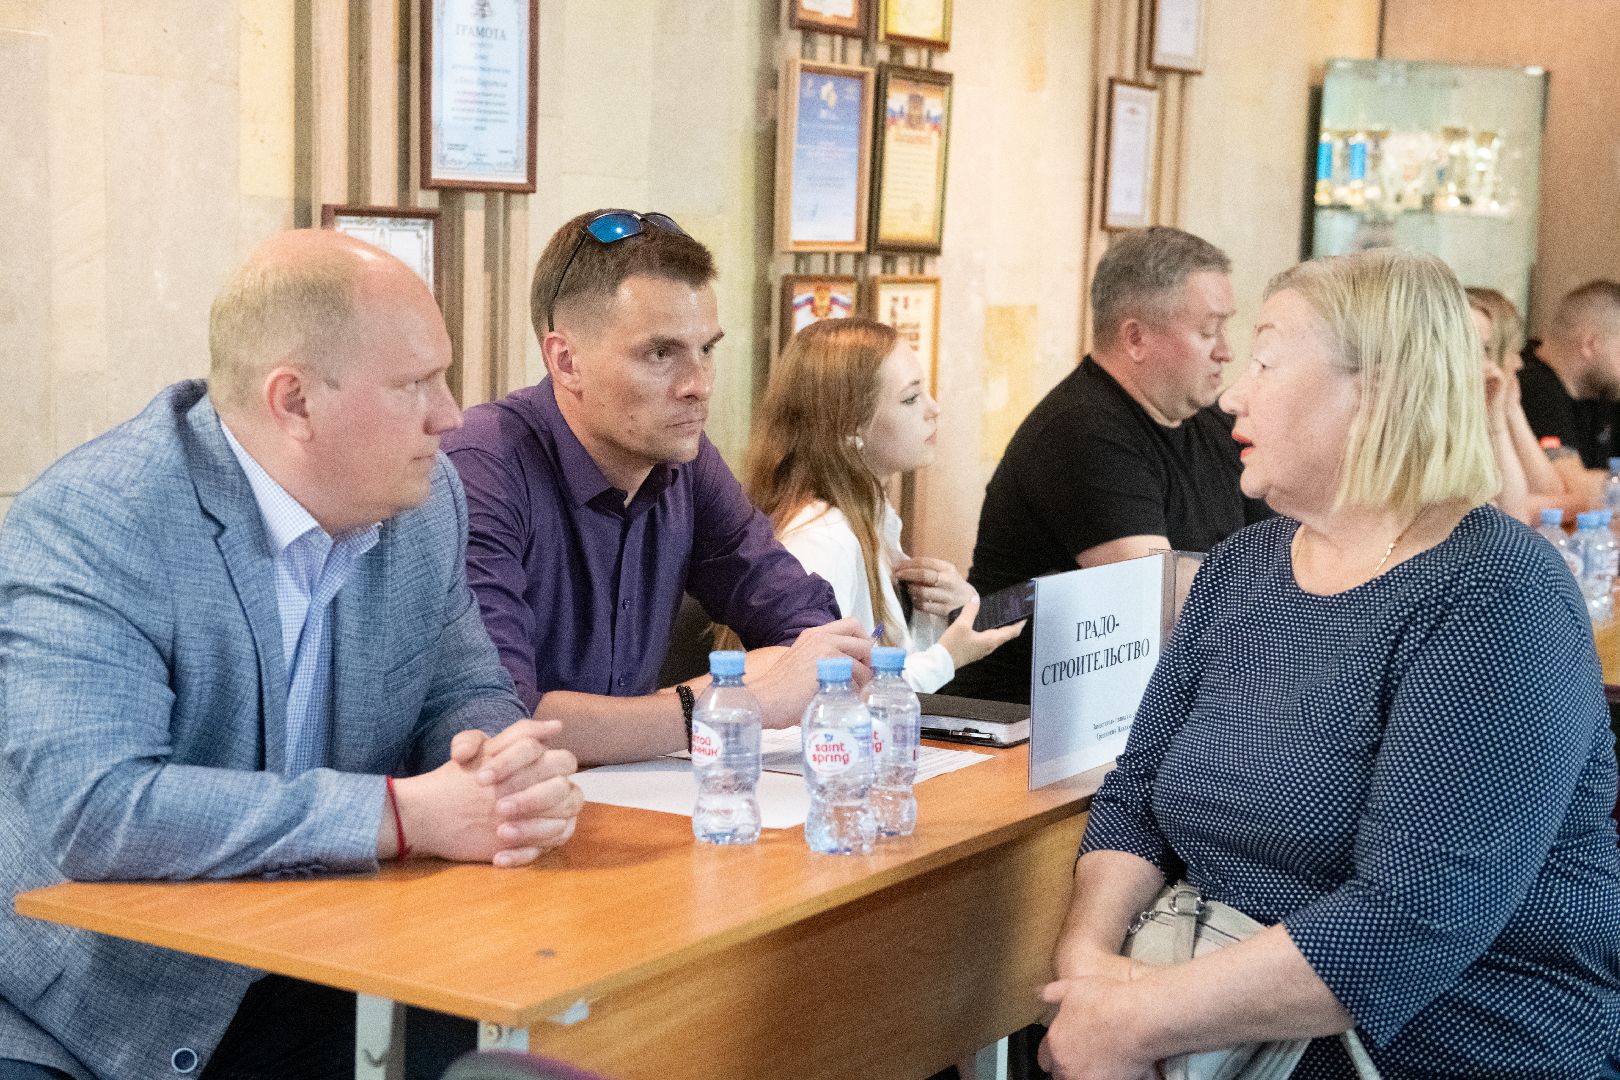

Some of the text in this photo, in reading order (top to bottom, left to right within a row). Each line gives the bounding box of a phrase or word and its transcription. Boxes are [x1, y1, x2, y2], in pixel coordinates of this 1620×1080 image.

[456, 24, 506, 40] ГРАМОТА
[1076, 614, 1120, 642] ГРАДО-
[1041, 638, 1150, 686] СТРОИТЕЛЬСТВО
[815, 742, 845, 752] saint
[812, 753, 849, 765] spring
